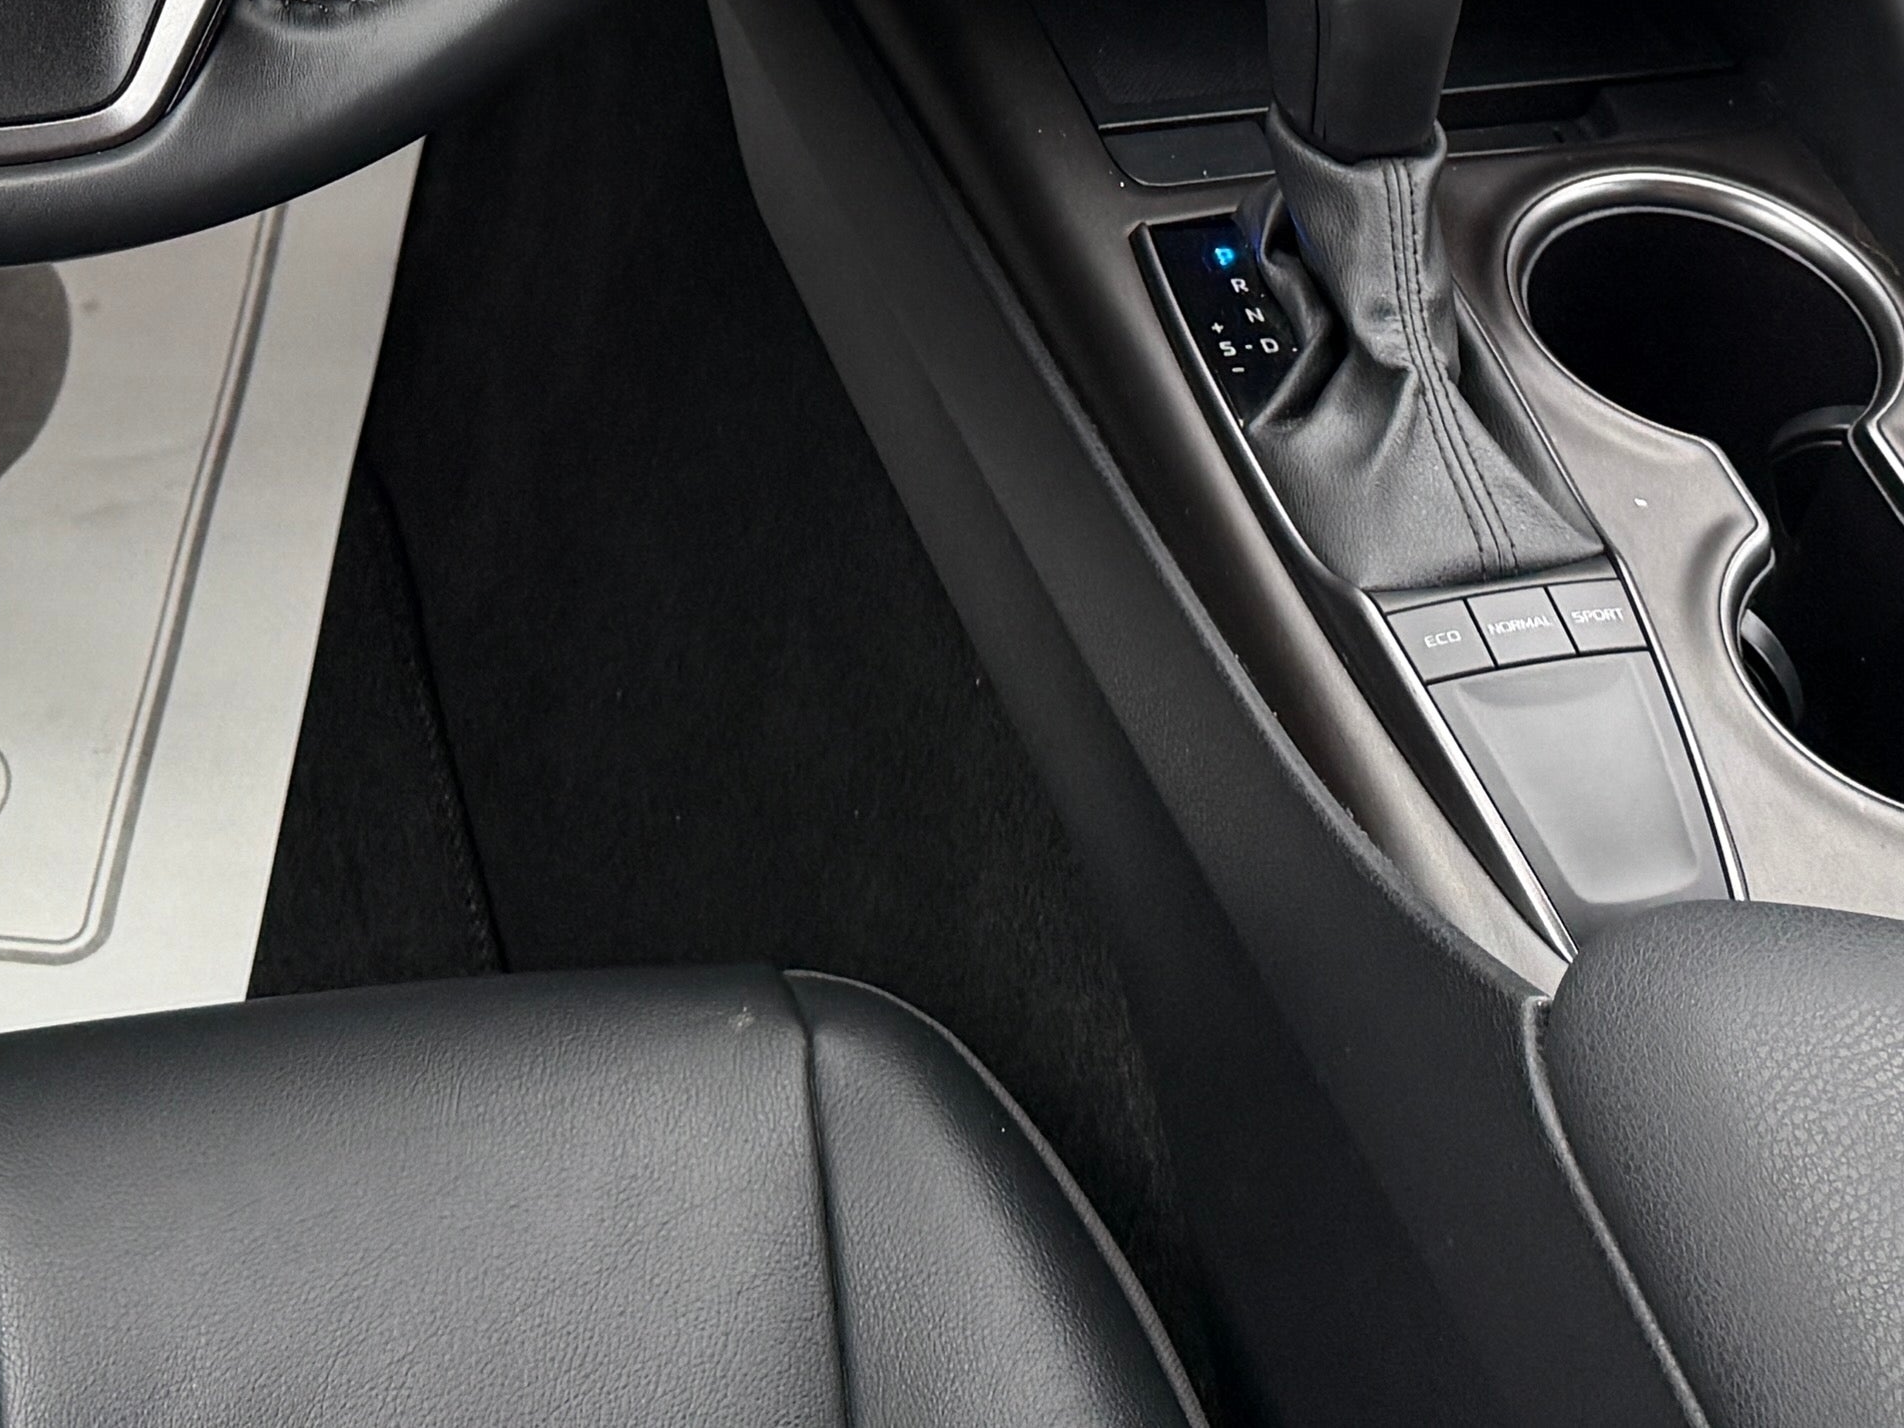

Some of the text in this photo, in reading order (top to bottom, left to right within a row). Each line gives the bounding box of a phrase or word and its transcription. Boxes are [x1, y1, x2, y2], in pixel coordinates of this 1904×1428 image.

[1230, 277, 1249, 293] R
[1245, 307, 1265, 324] N
[1218, 341, 1237, 357] S
[1260, 338, 1279, 354] D
[1570, 606, 1624, 624] SPORT
[1487, 614, 1554, 635] NORMAL
[1424, 629, 1462, 648] ECO
